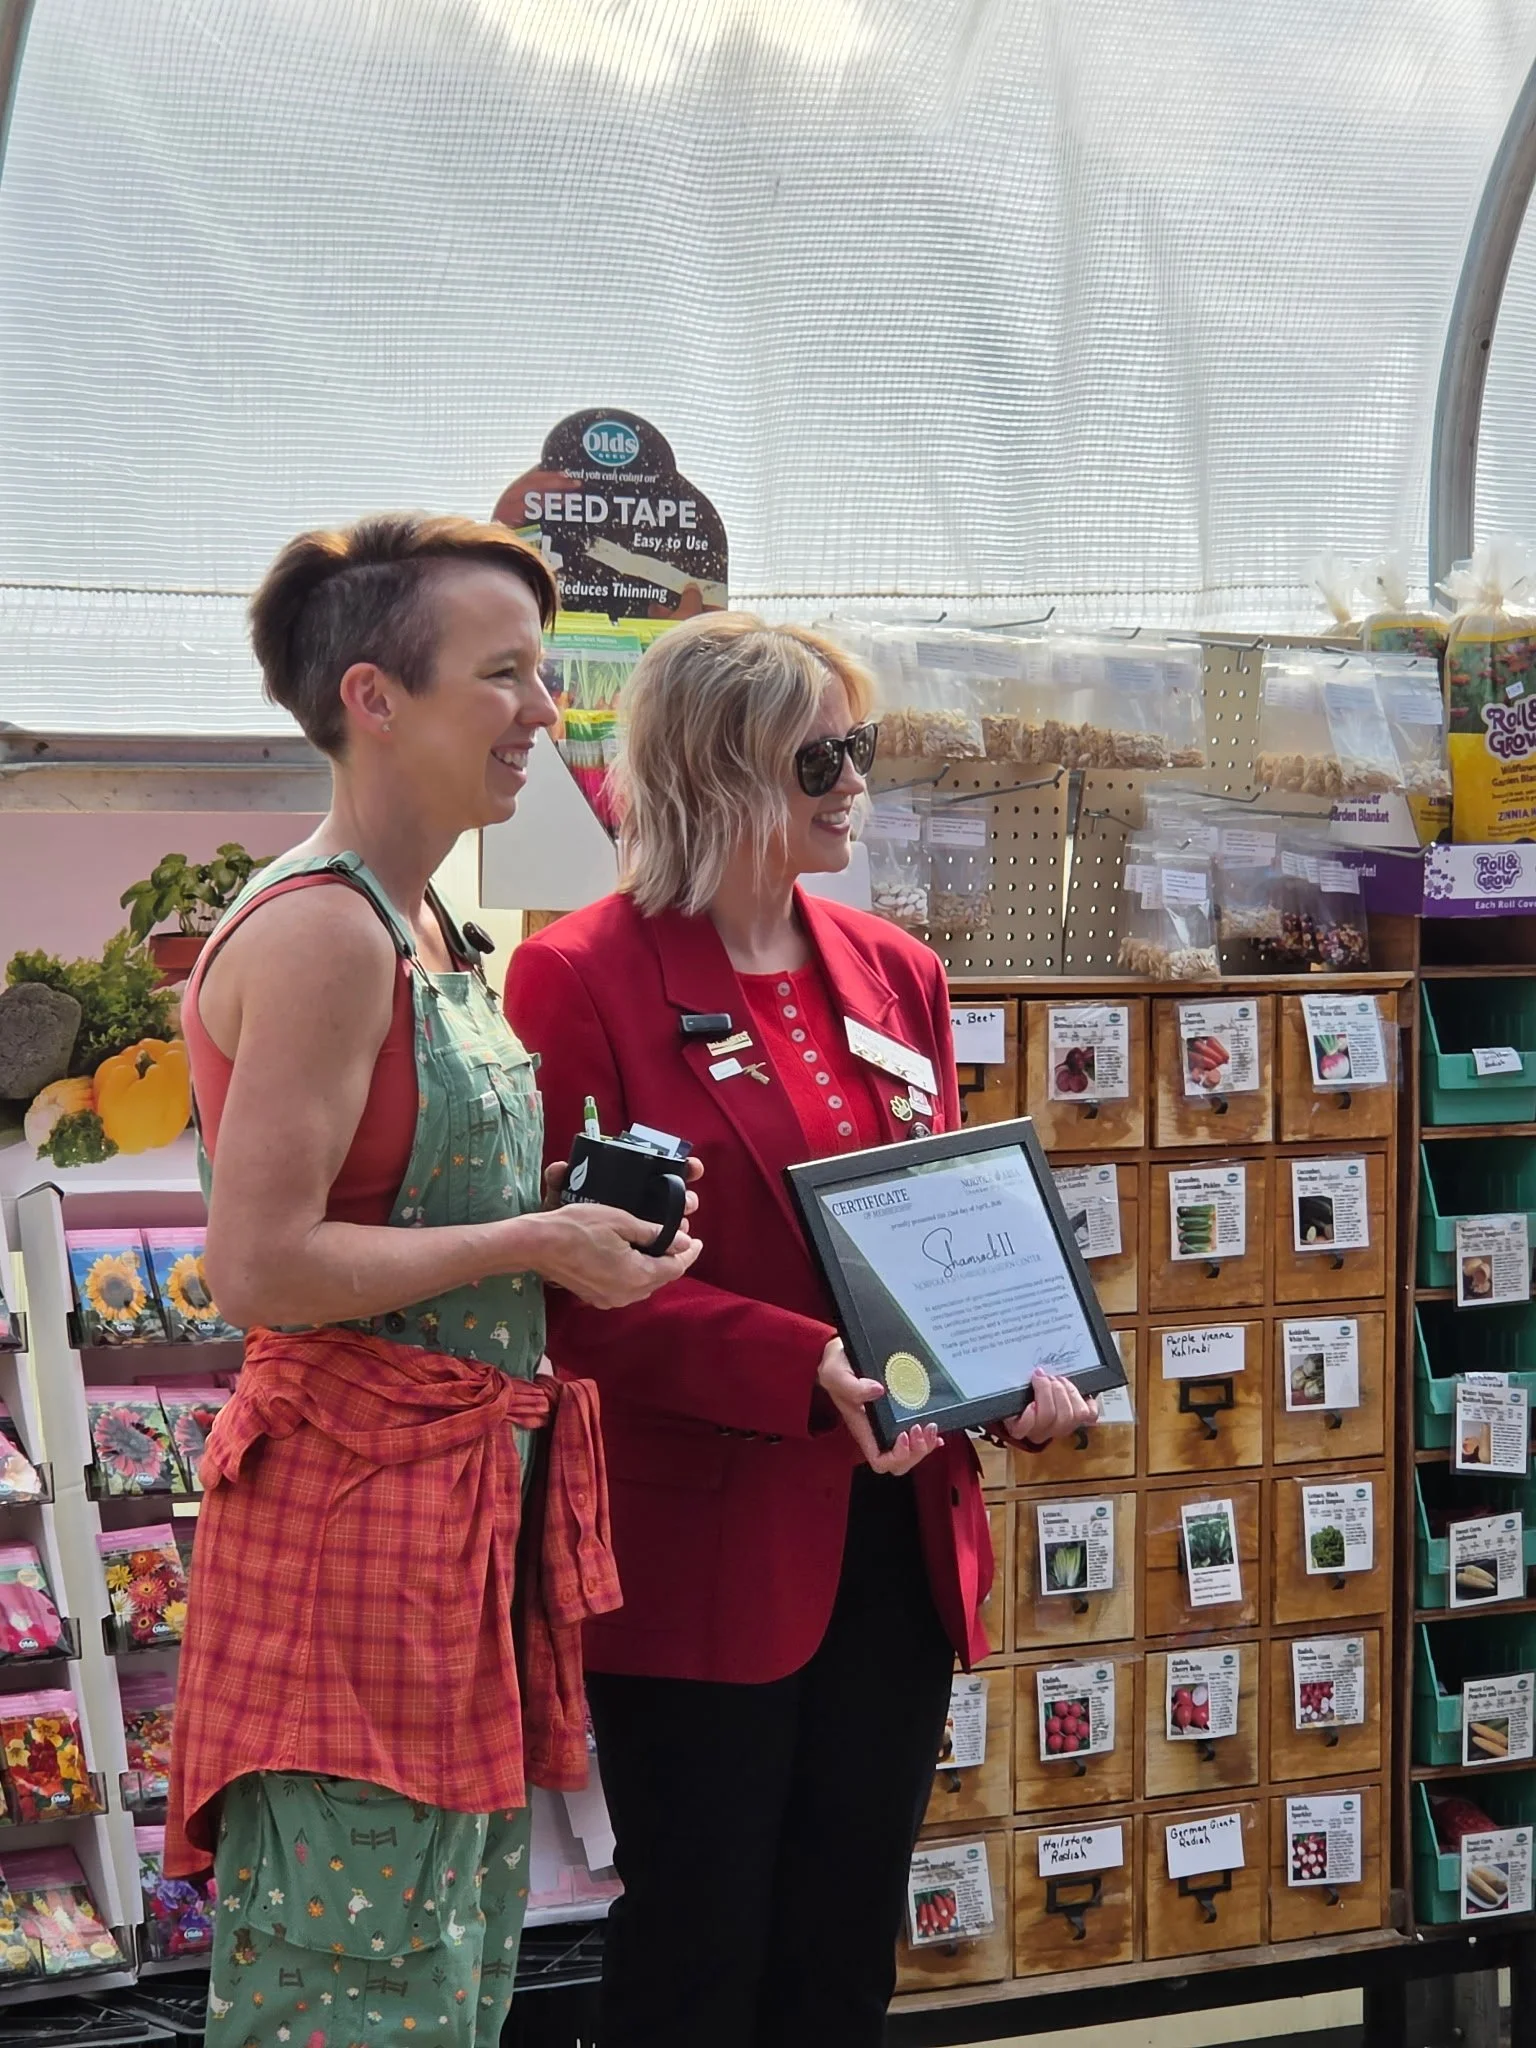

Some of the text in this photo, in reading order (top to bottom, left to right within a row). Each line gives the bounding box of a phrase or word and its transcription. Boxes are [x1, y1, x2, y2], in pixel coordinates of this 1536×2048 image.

[583, 431, 638, 454] Olds
[524, 491, 697, 529] SEED TAPE
[633, 532, 709, 551] Easy to Use
[612, 582, 668, 603] Thinning
[1358, 807, 1389, 823] Blanket
[1475, 901, 1496, 910] Each
[1498, 900, 1515, 909] Roll
[967, 1012, 996, 1024] Beet
[831, 1188, 911, 1217] CERTIFICATE
[1166, 1331, 1234, 1346] Purple Vienna
[1170, 1817, 1237, 1840] German Giant
[1042, 1835, 1094, 1852] Hailstone
[1179, 1836, 1212, 1848] Radish
[1051, 1846, 1088, 1864] Radish
